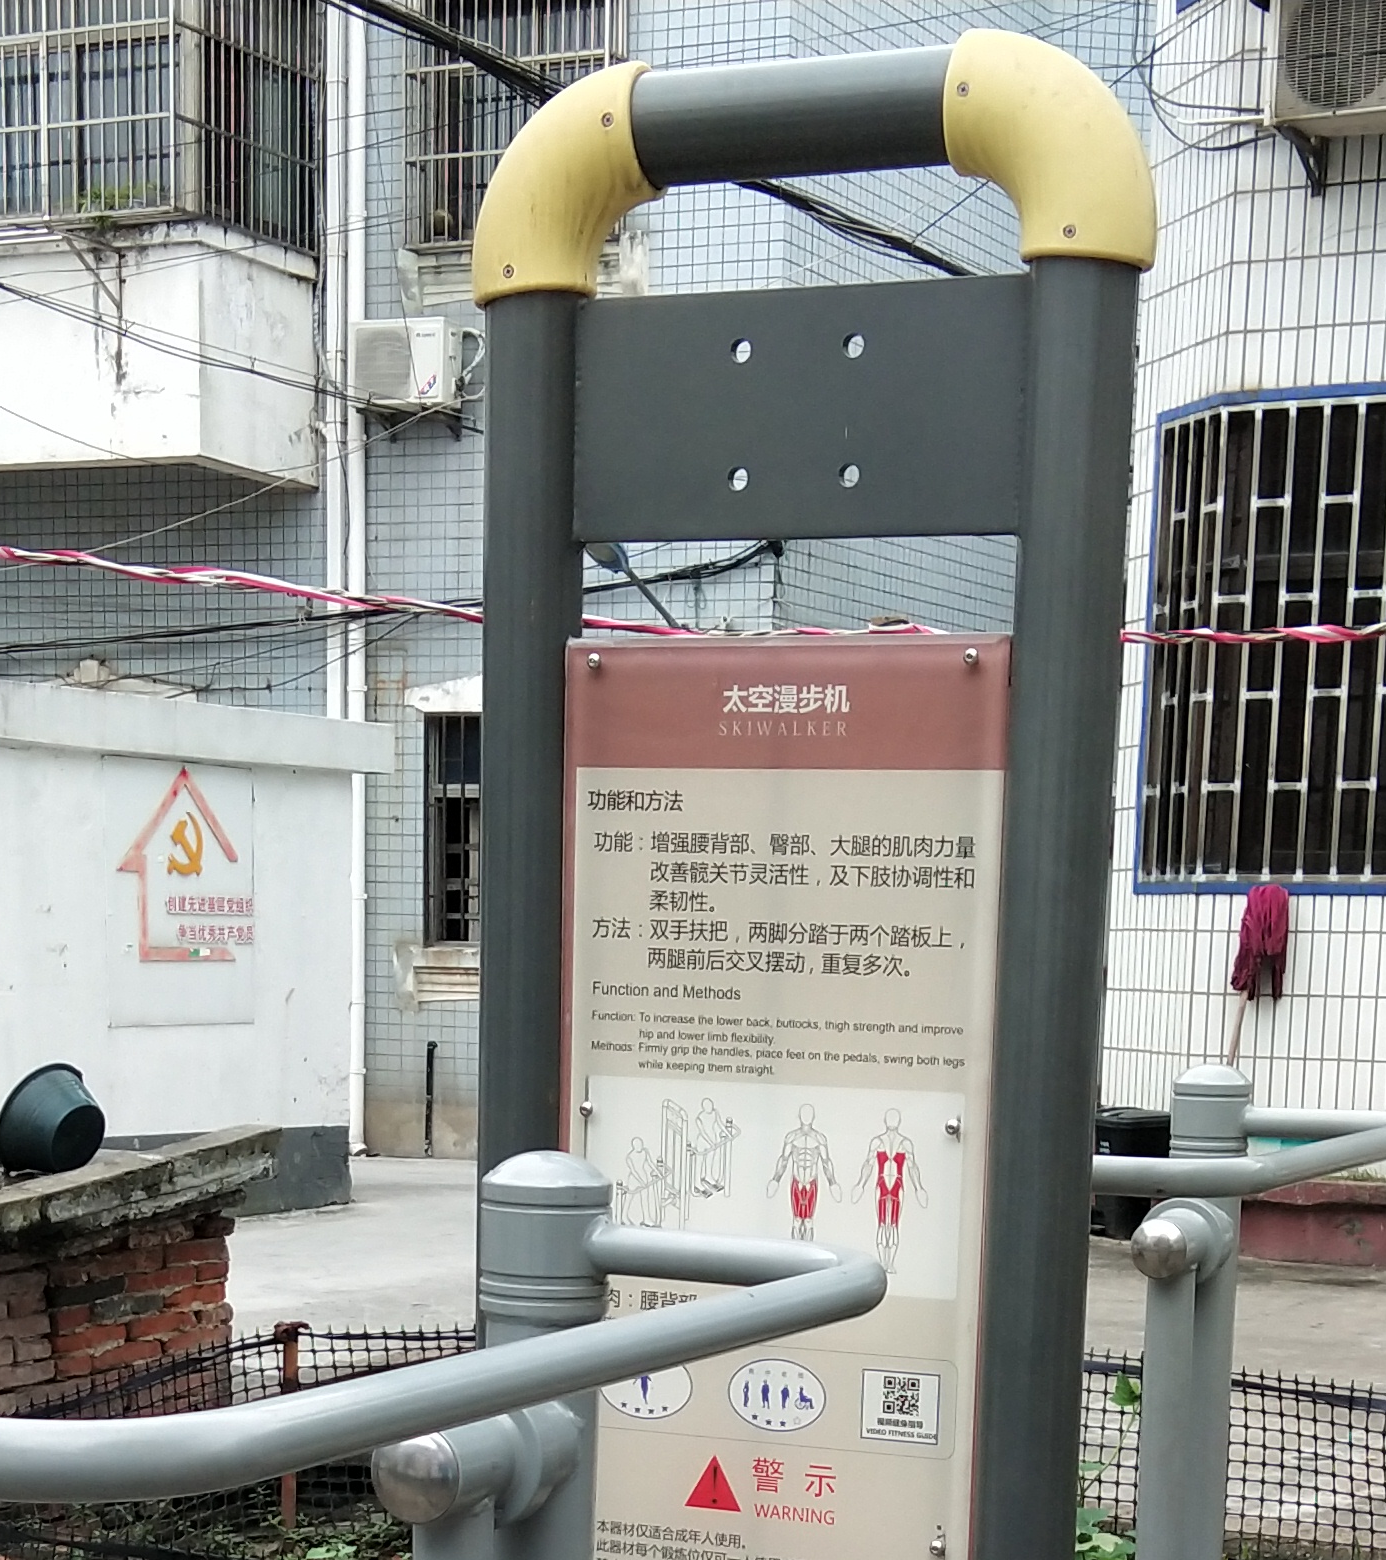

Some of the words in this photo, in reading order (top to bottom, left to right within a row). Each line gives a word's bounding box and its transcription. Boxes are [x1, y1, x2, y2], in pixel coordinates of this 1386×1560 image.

[723, 684, 850, 714] 太空漫步机
[718, 721, 847, 736] SKIWALKER
[587, 790, 683, 812] 功能和方法
[168, 896, 253, 913] 创建先进基层党组织
[649, 890, 716, 912] 柔韧性。
[178, 924, 253, 941] 争当优秀共产党员
[592, 980, 649, 997] Function
[653, 982, 678, 998] and
[682, 983, 740, 1000] Methods
[754, 1504, 835, 1525] WARNING
